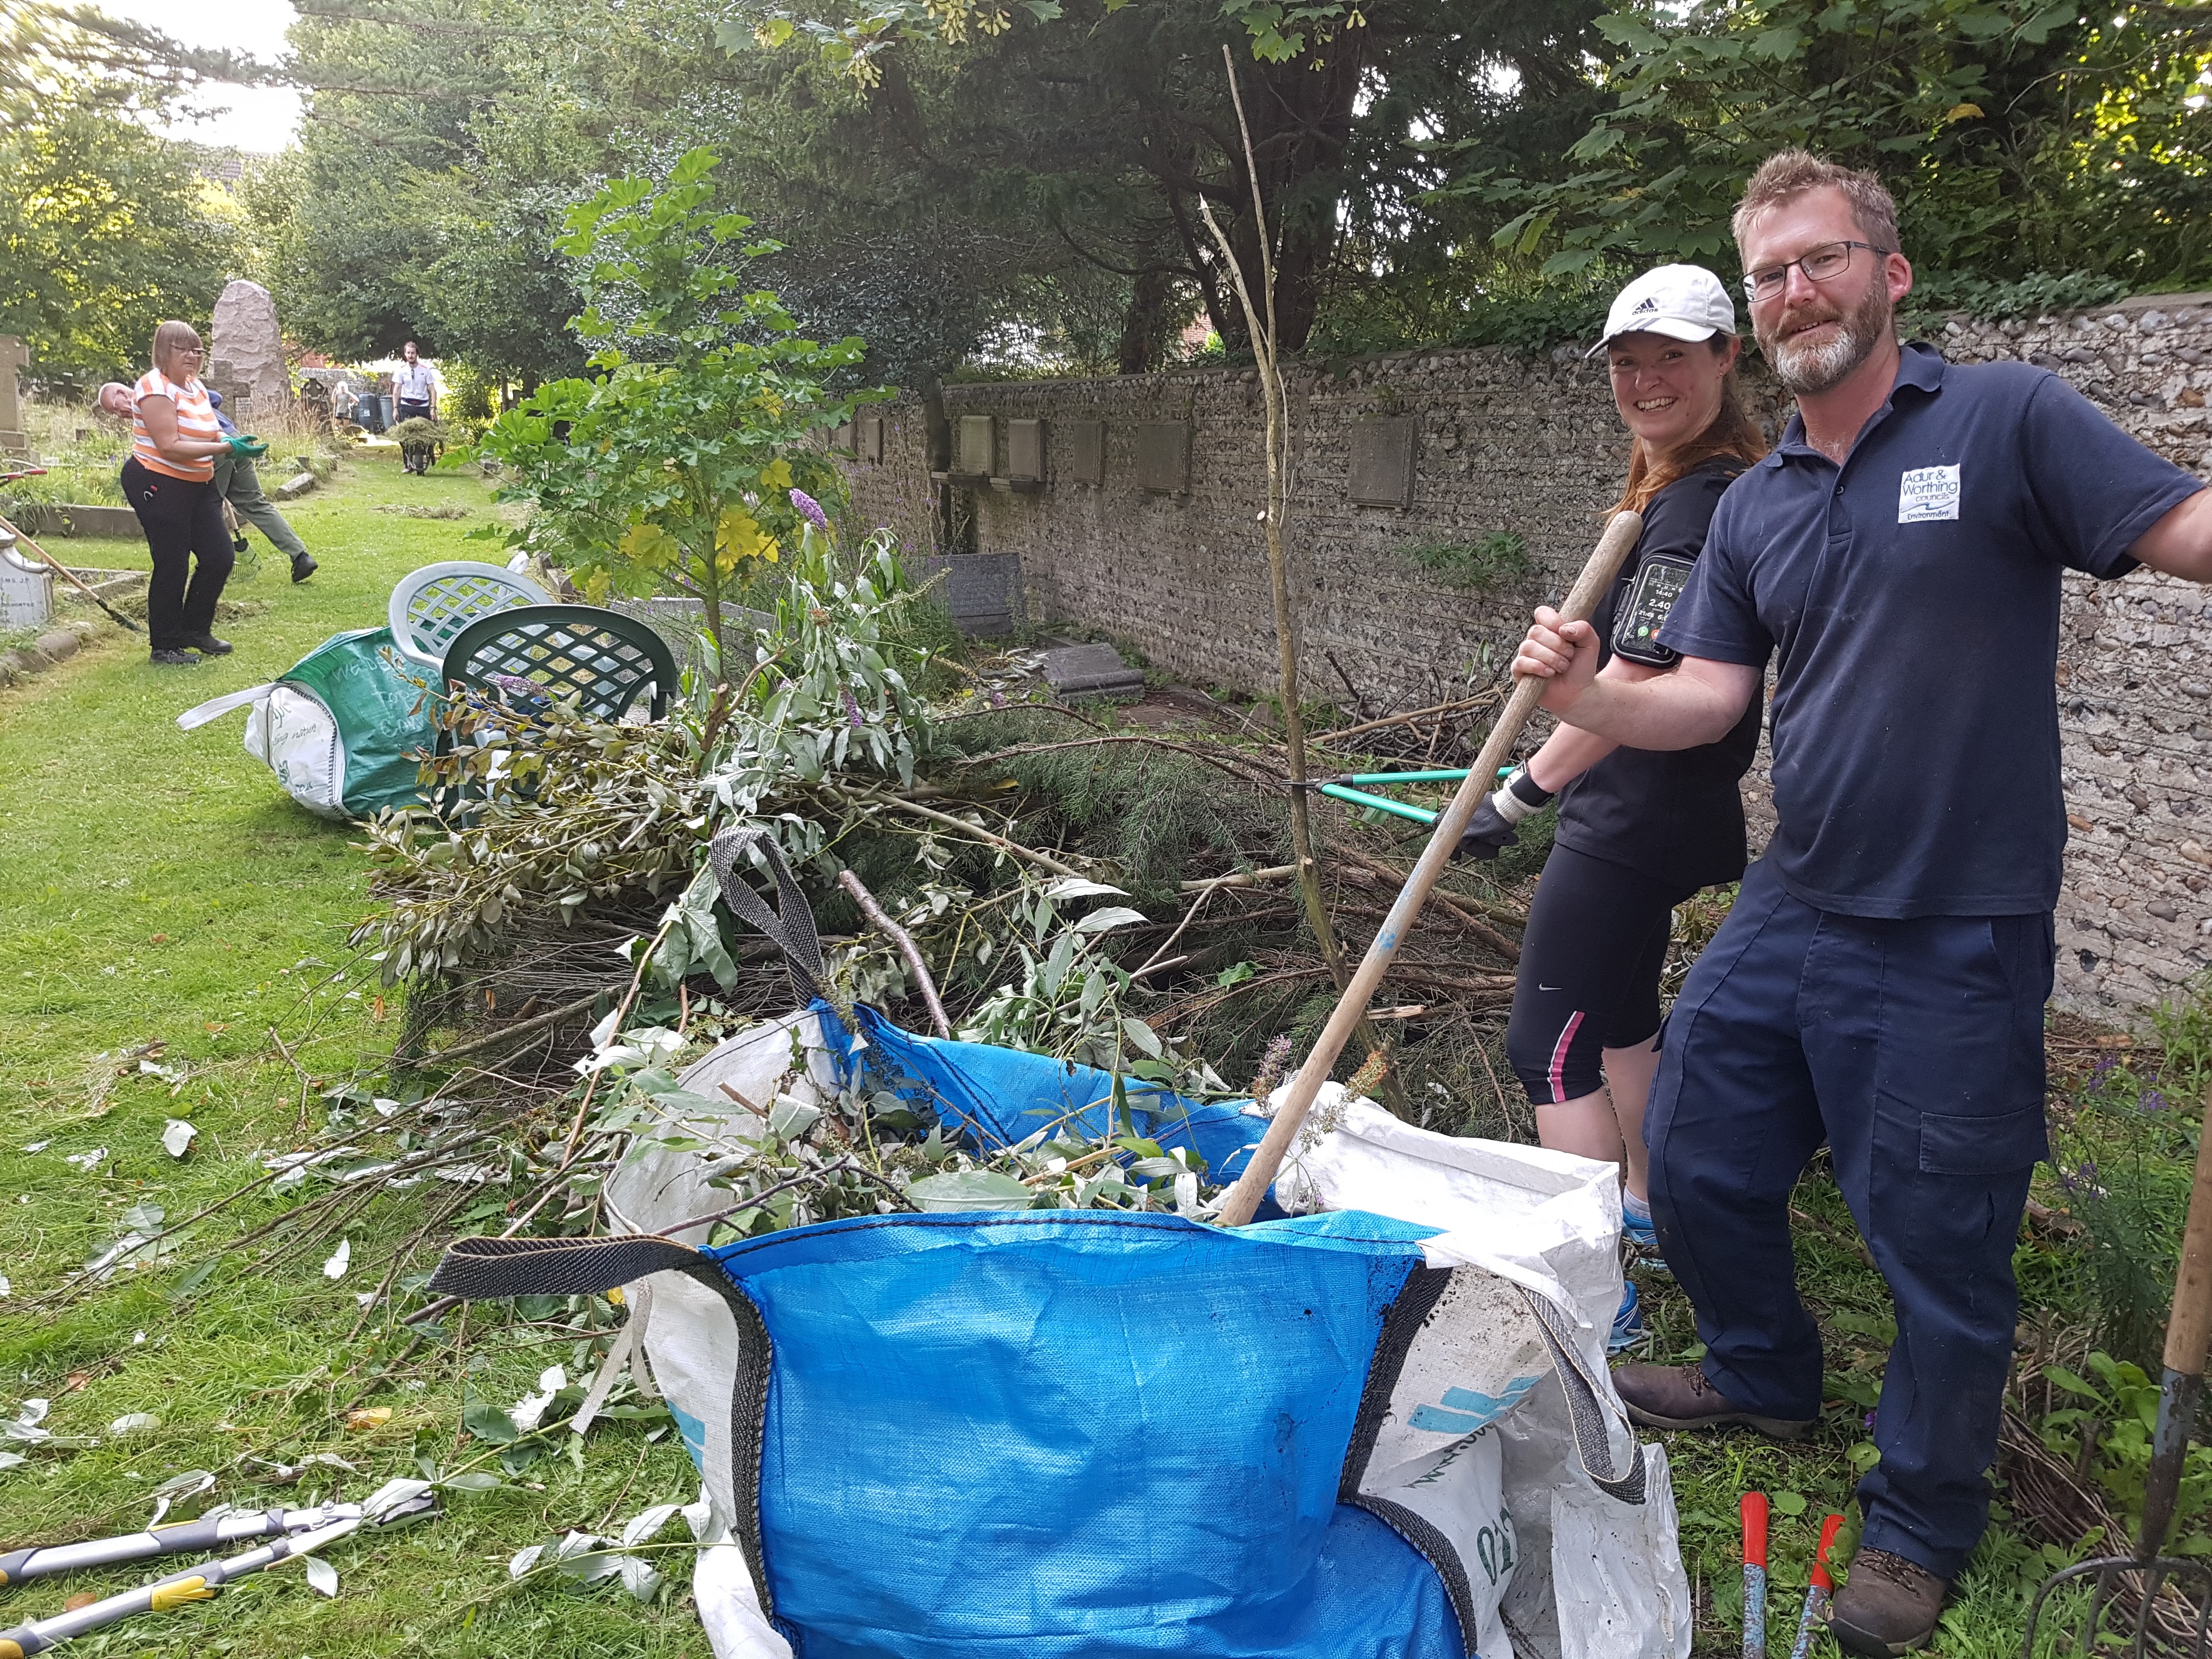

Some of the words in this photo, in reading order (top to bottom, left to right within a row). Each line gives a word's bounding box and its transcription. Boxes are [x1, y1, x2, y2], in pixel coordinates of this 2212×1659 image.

[1904, 471, 1934, 484] Adur
[1936, 470, 1946, 479] &
[1903, 481, 1959, 496] Worthing
[1916, 493, 1949, 502] councils
[1908, 510, 1949, 520] Environment
[1649, 599, 1671, 610] 2.40
